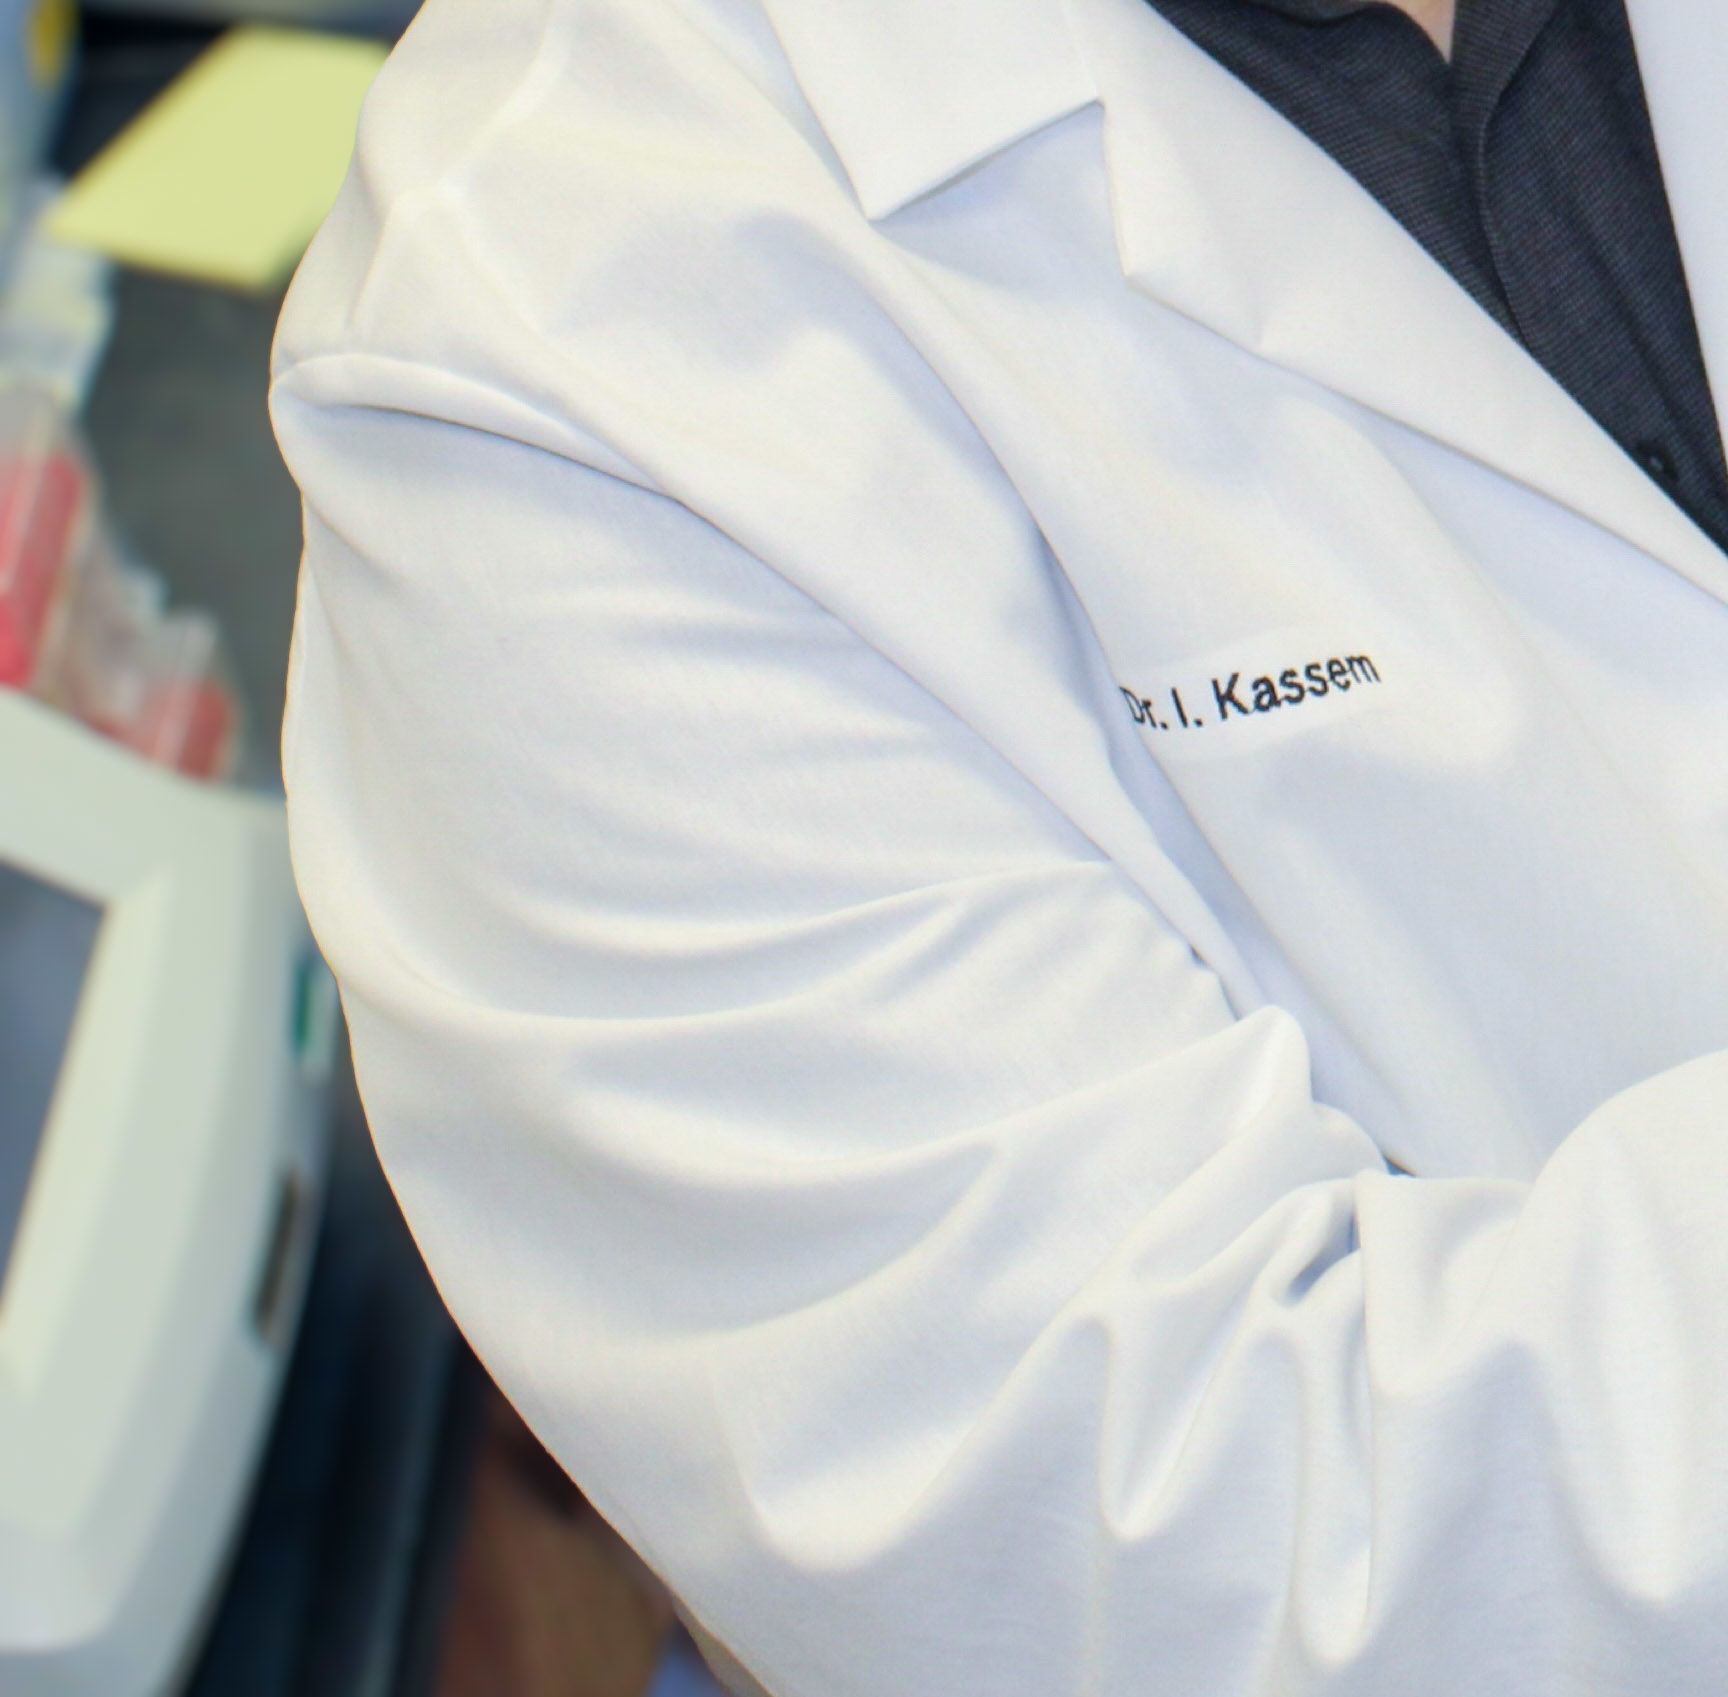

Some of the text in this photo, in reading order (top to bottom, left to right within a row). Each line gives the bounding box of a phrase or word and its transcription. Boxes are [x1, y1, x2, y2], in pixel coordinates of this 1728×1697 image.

[1119, 654, 1382, 730] Dr. I. Kassem
